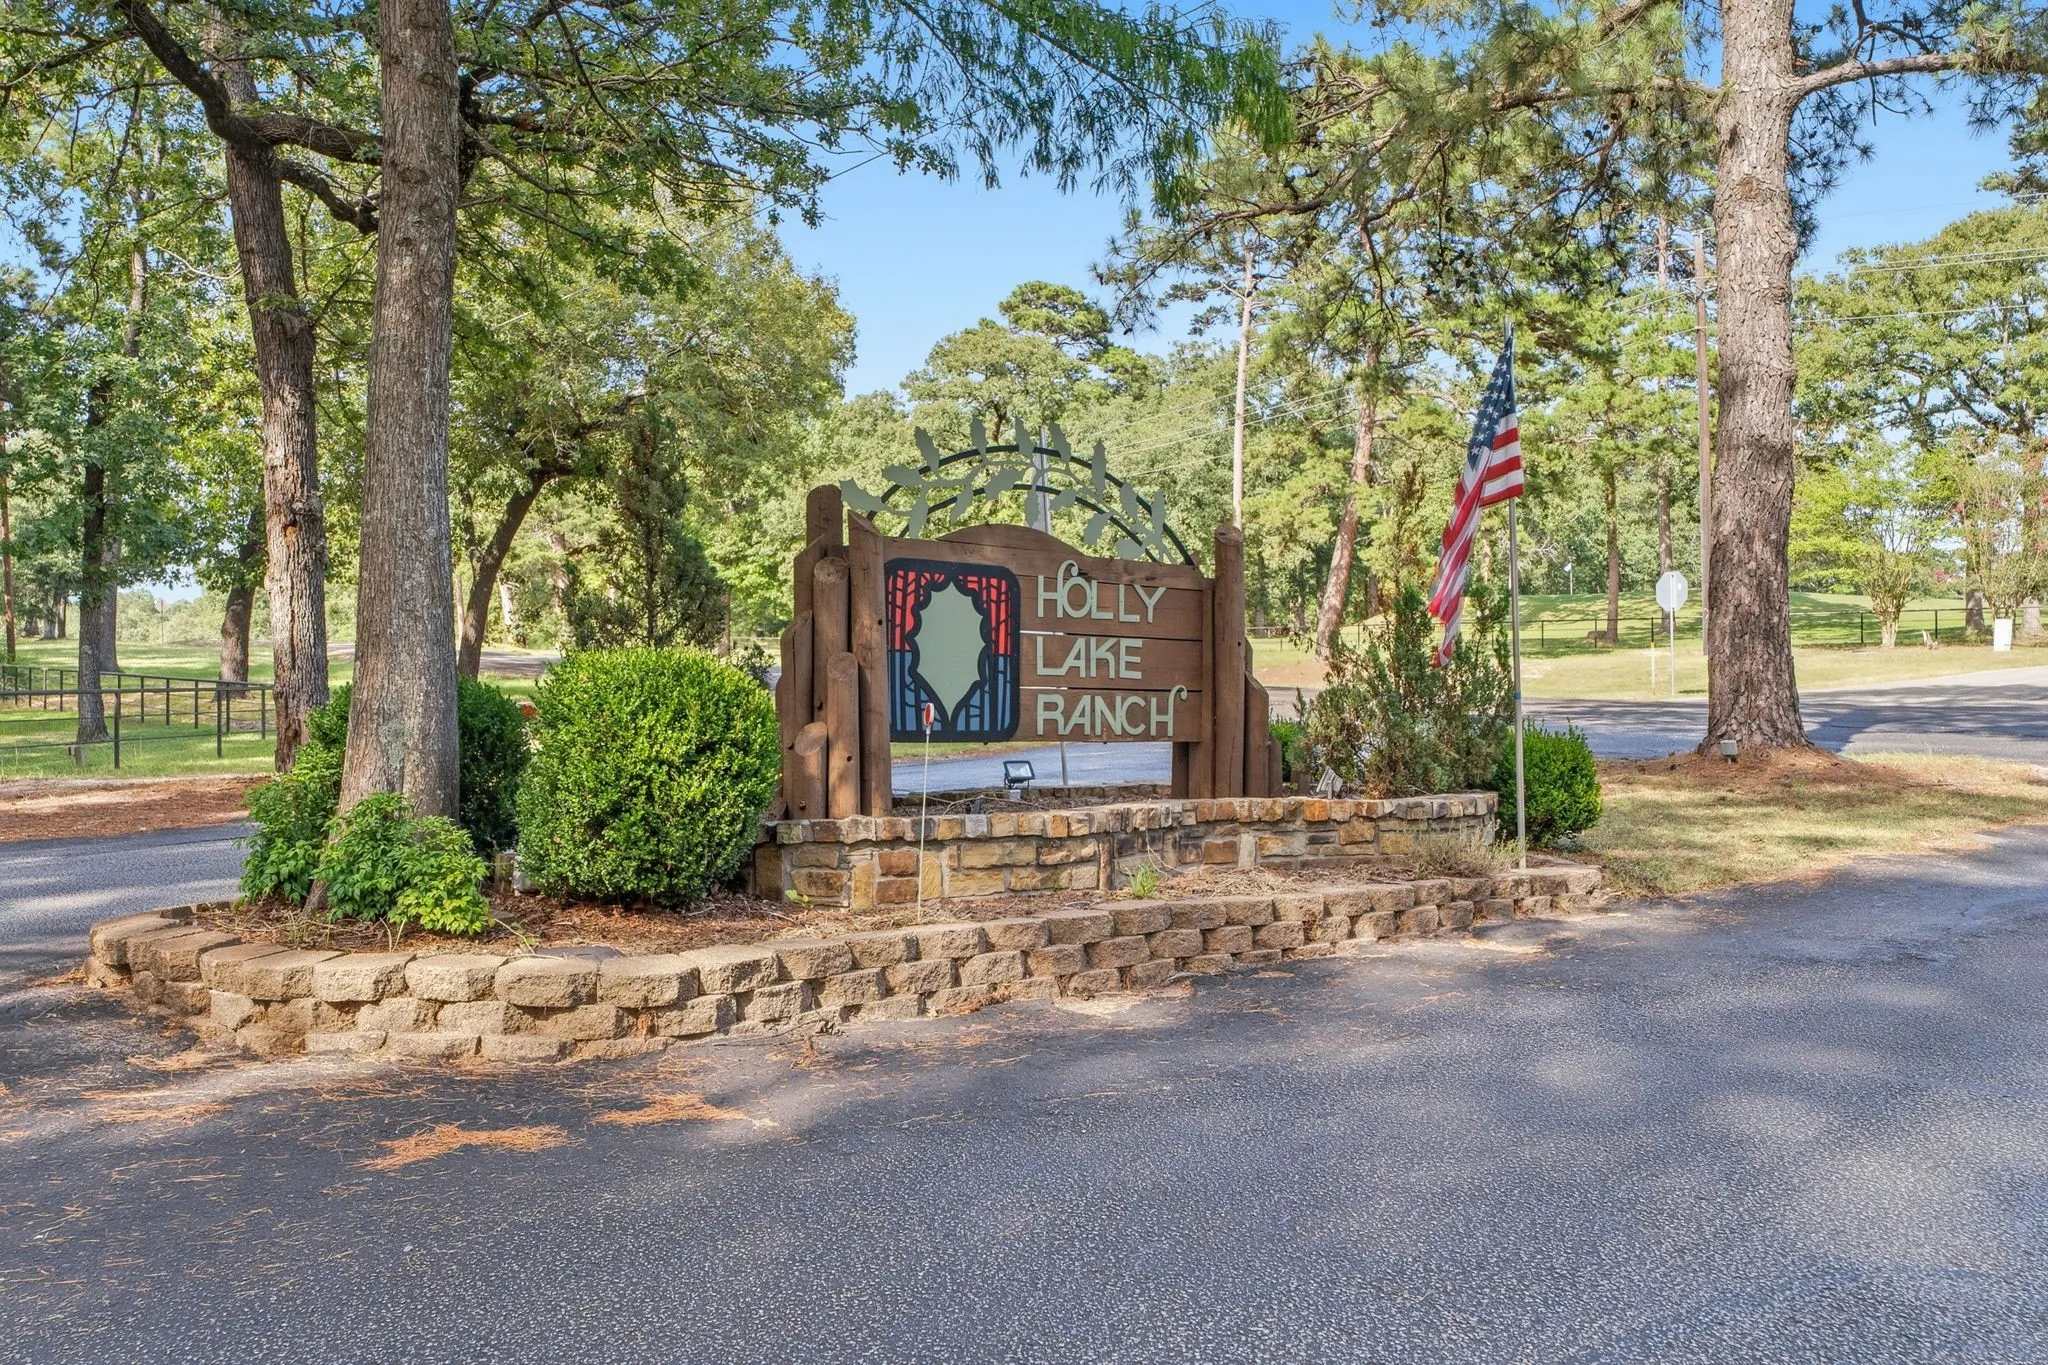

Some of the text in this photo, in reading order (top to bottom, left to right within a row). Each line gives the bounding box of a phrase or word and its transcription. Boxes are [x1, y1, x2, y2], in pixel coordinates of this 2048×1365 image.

[1037, 560, 1167, 623] HOLLY
[1036, 636, 1143, 680] LAKE
[1036, 685, 1188, 737] RANCH
